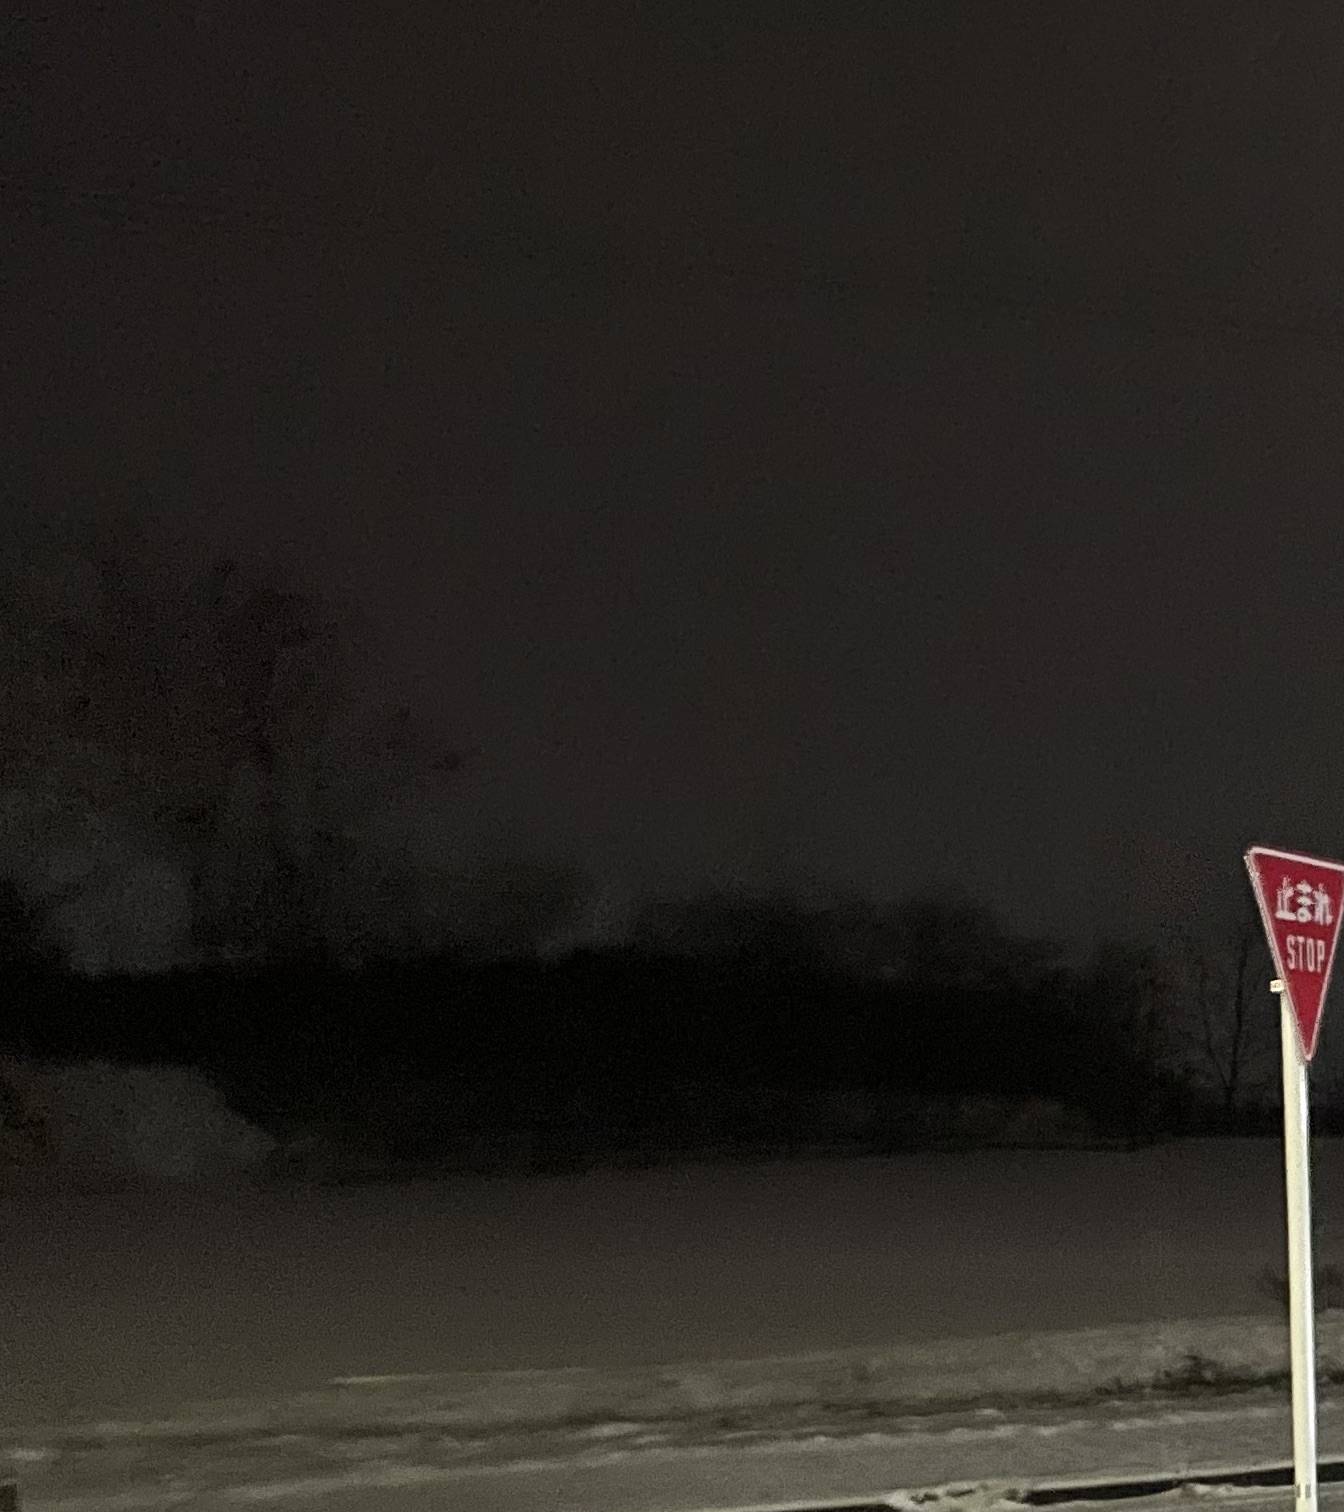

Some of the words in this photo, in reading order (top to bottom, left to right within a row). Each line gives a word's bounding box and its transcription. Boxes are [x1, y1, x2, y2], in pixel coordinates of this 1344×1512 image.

[1276, 877, 1332, 925] 止まれ
[1285, 934, 1326, 973] STOP
